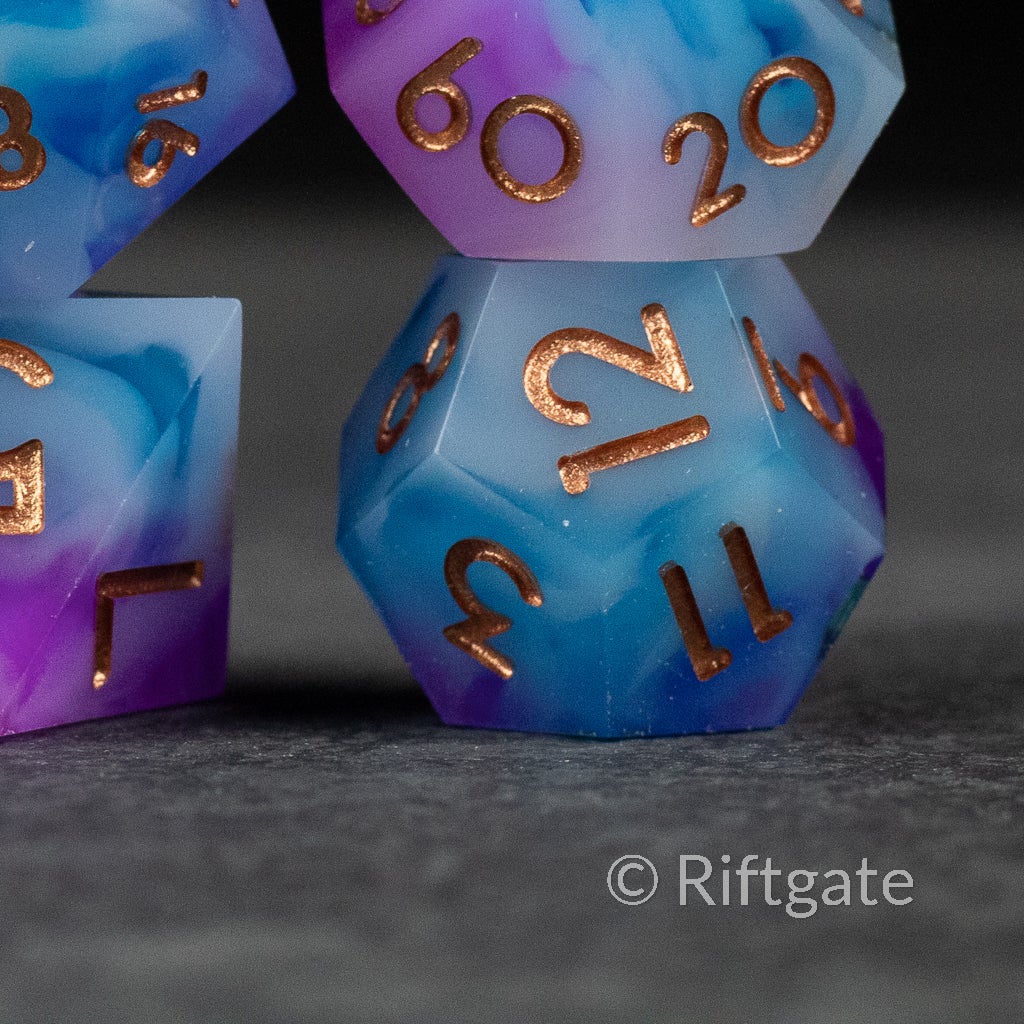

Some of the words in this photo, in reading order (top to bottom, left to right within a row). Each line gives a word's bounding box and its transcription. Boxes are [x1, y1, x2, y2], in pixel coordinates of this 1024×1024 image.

[126, 70, 210, 188] 16
[395, 36, 584, 205] 60
[662, 56, 836, 229] 20
[376, 312, 460, 454] 8
[522, 302, 712, 495] 12
[443, 538, 543, 680] 3
[657, 521, 794, 682] 11
